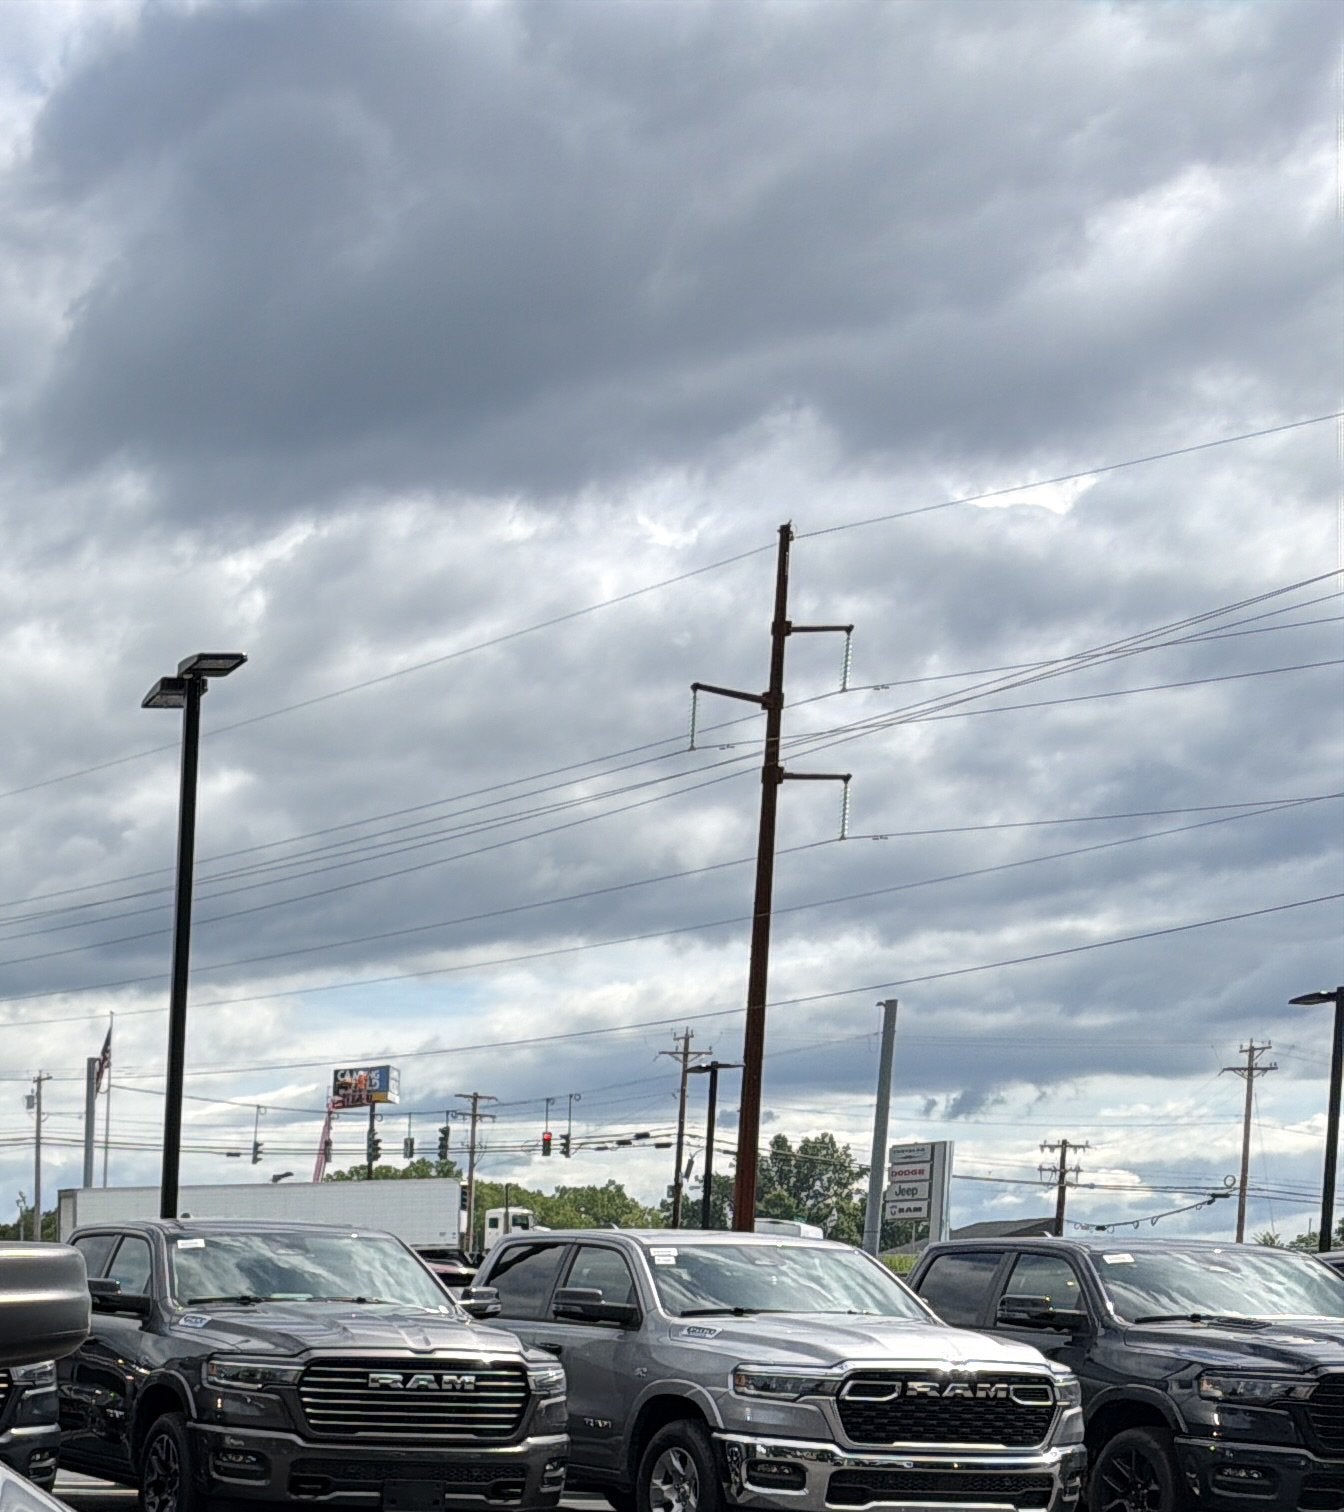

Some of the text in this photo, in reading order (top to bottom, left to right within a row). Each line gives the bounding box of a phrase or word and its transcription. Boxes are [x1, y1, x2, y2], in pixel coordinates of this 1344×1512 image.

[895, 1185, 918, 1198] Jeep
[368, 1373, 476, 1390] RAM
[906, 1381, 1009, 1398] RAM
